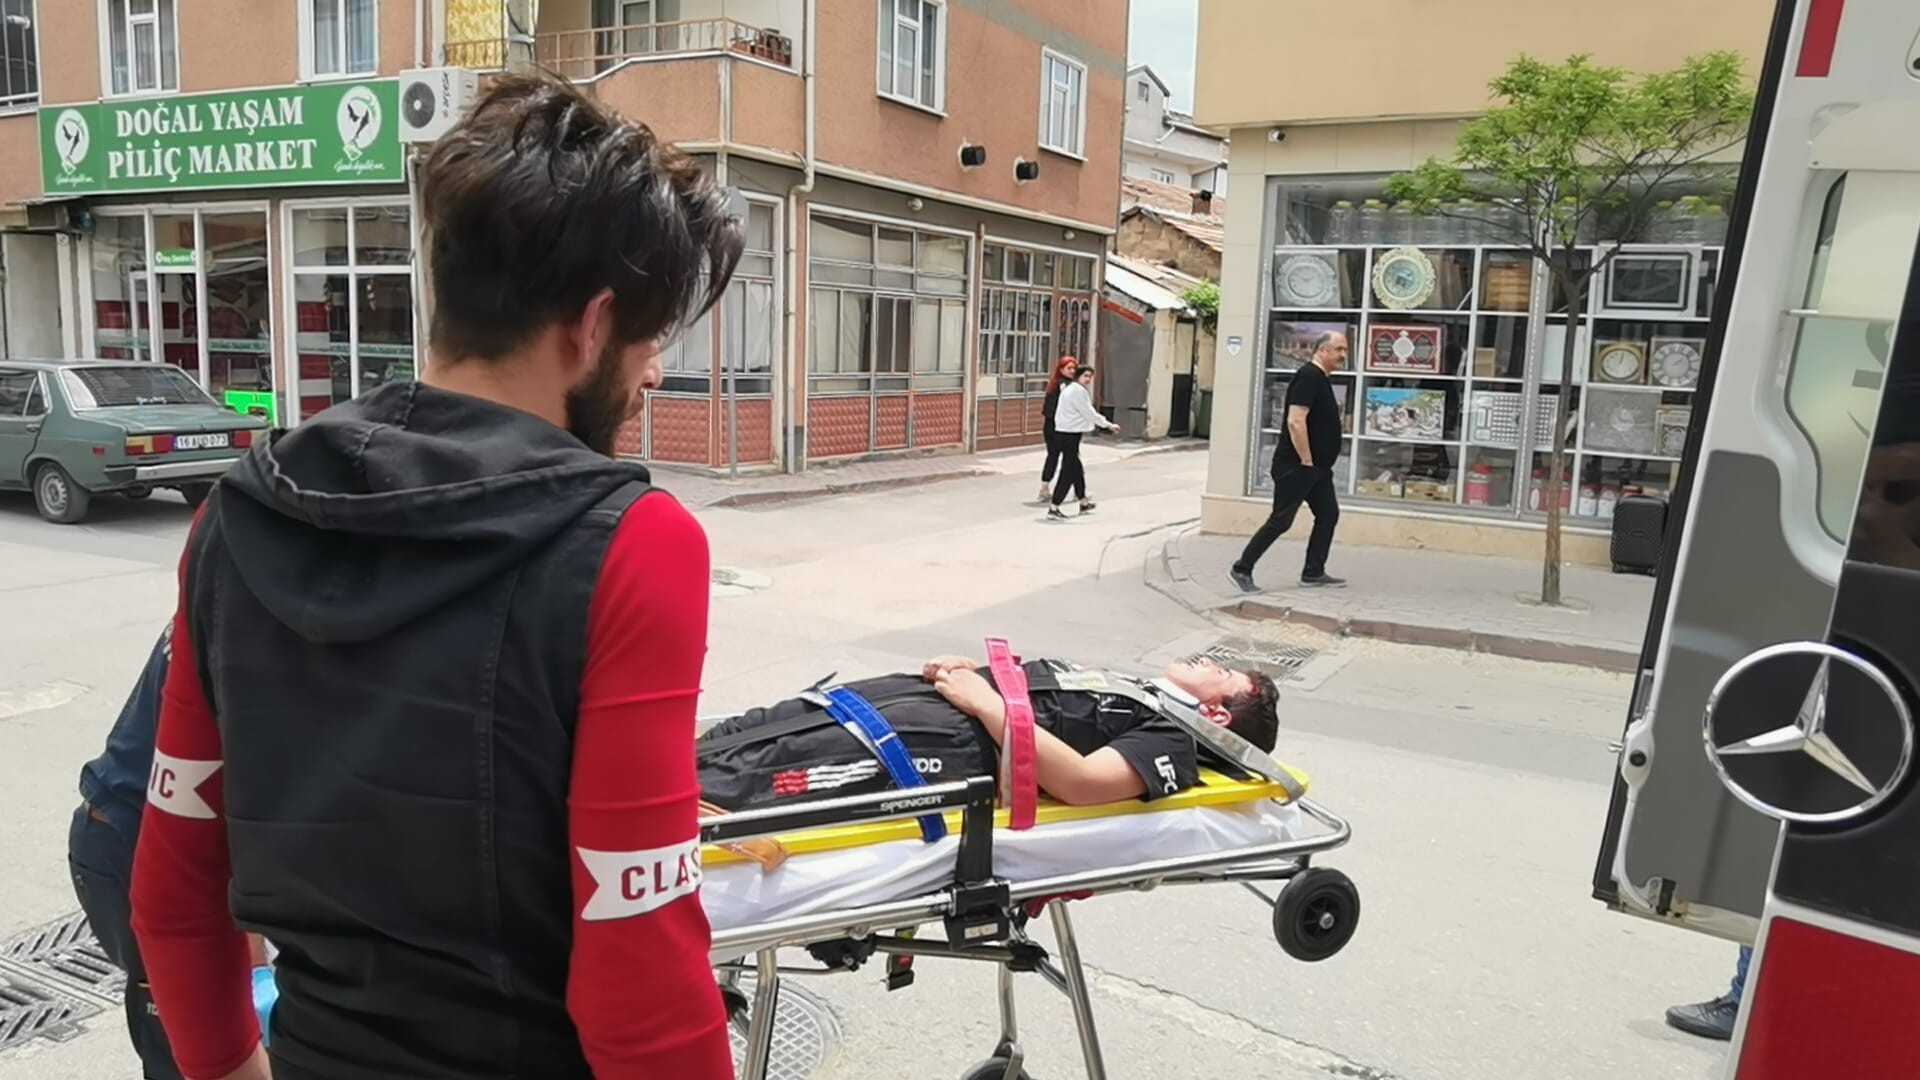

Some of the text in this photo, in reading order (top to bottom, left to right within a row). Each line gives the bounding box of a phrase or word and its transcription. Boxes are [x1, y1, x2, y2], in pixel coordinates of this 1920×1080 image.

[115, 96, 304, 138] DOĞAL YAŞAM
[108, 139, 182, 182] PİLİÇ
[189, 139, 317, 175] MARKET
[1154, 755, 1178, 794] UFC
[880, 795, 945, 813] SPENCER
